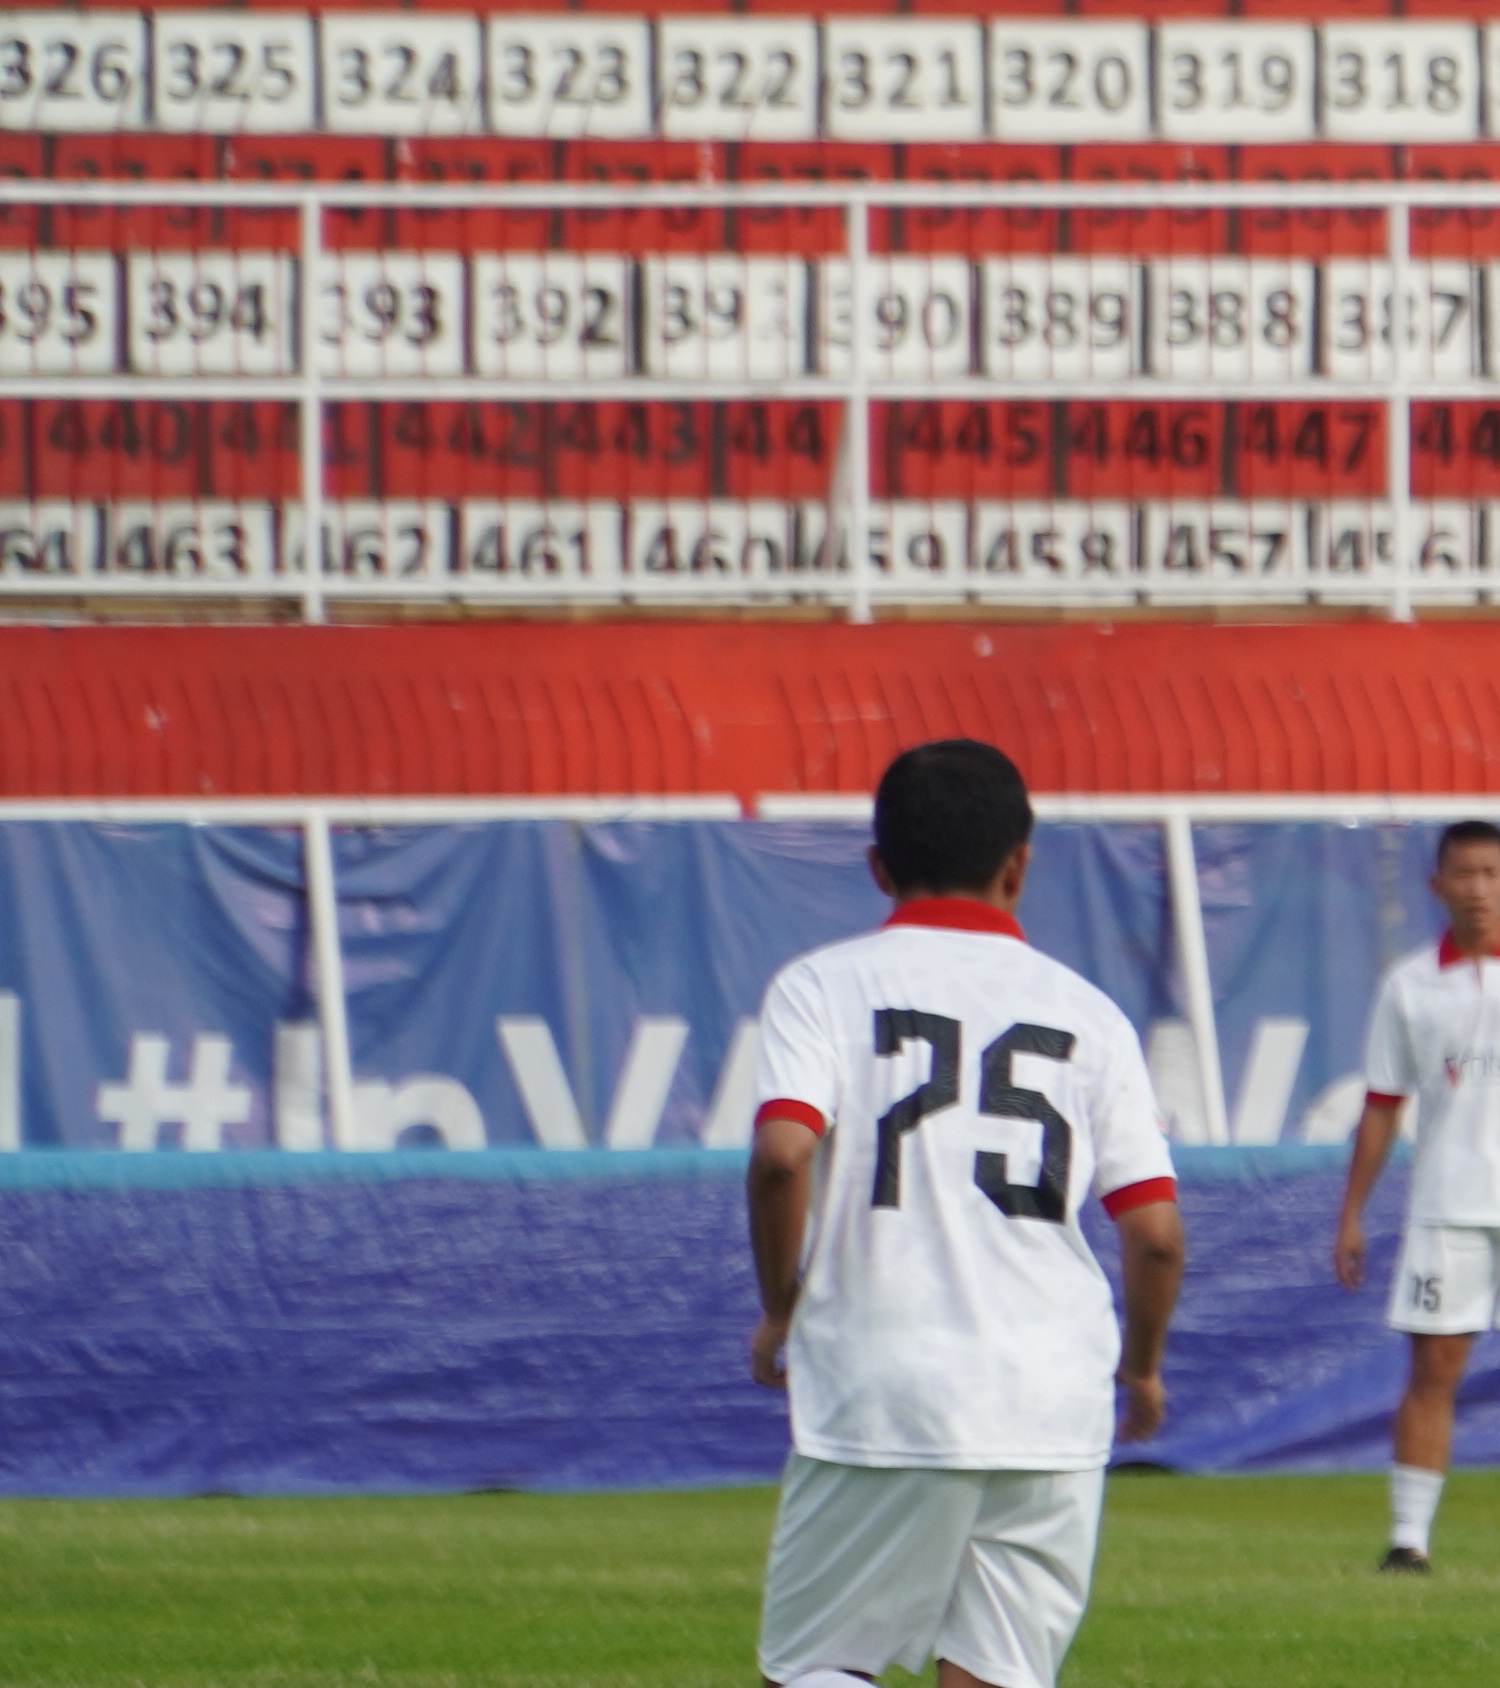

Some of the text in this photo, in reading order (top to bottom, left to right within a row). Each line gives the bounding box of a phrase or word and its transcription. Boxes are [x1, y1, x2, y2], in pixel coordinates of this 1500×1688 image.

[0, 39, 130, 100] 326
[166, 42, 295, 99] 325
[337, 45, 460, 104] 324
[500, 44, 630, 102] 323
[672, 47, 800, 108] 322
[840, 48, 968, 109] 321
[1003, 48, 1134, 113] 320
[1171, 49, 1296, 115] 319
[1334, 51, 1462, 116] 318
[0, 282, 97, 345] 95
[145, 279, 267, 344] 394
[319, 283, 442, 347] 393
[493, 284, 618, 348] 392
[997, 287, 1130, 351] 389
[1167, 289, 1299, 351] 388
[1335, 289, 1468, 353] 387
[730, 404, 838, 468] 44
[904, 405, 1045, 469] 445
[1067, 405, 1212, 470] 446
[1251, 406, 1378, 475] 447
[119, 524, 247, 572] 463
[471, 525, 589, 572] 461
[644, 528, 782, 572] 460
[1163, 528, 1285, 572] 457
[872, 1008, 1077, 1225] 75
